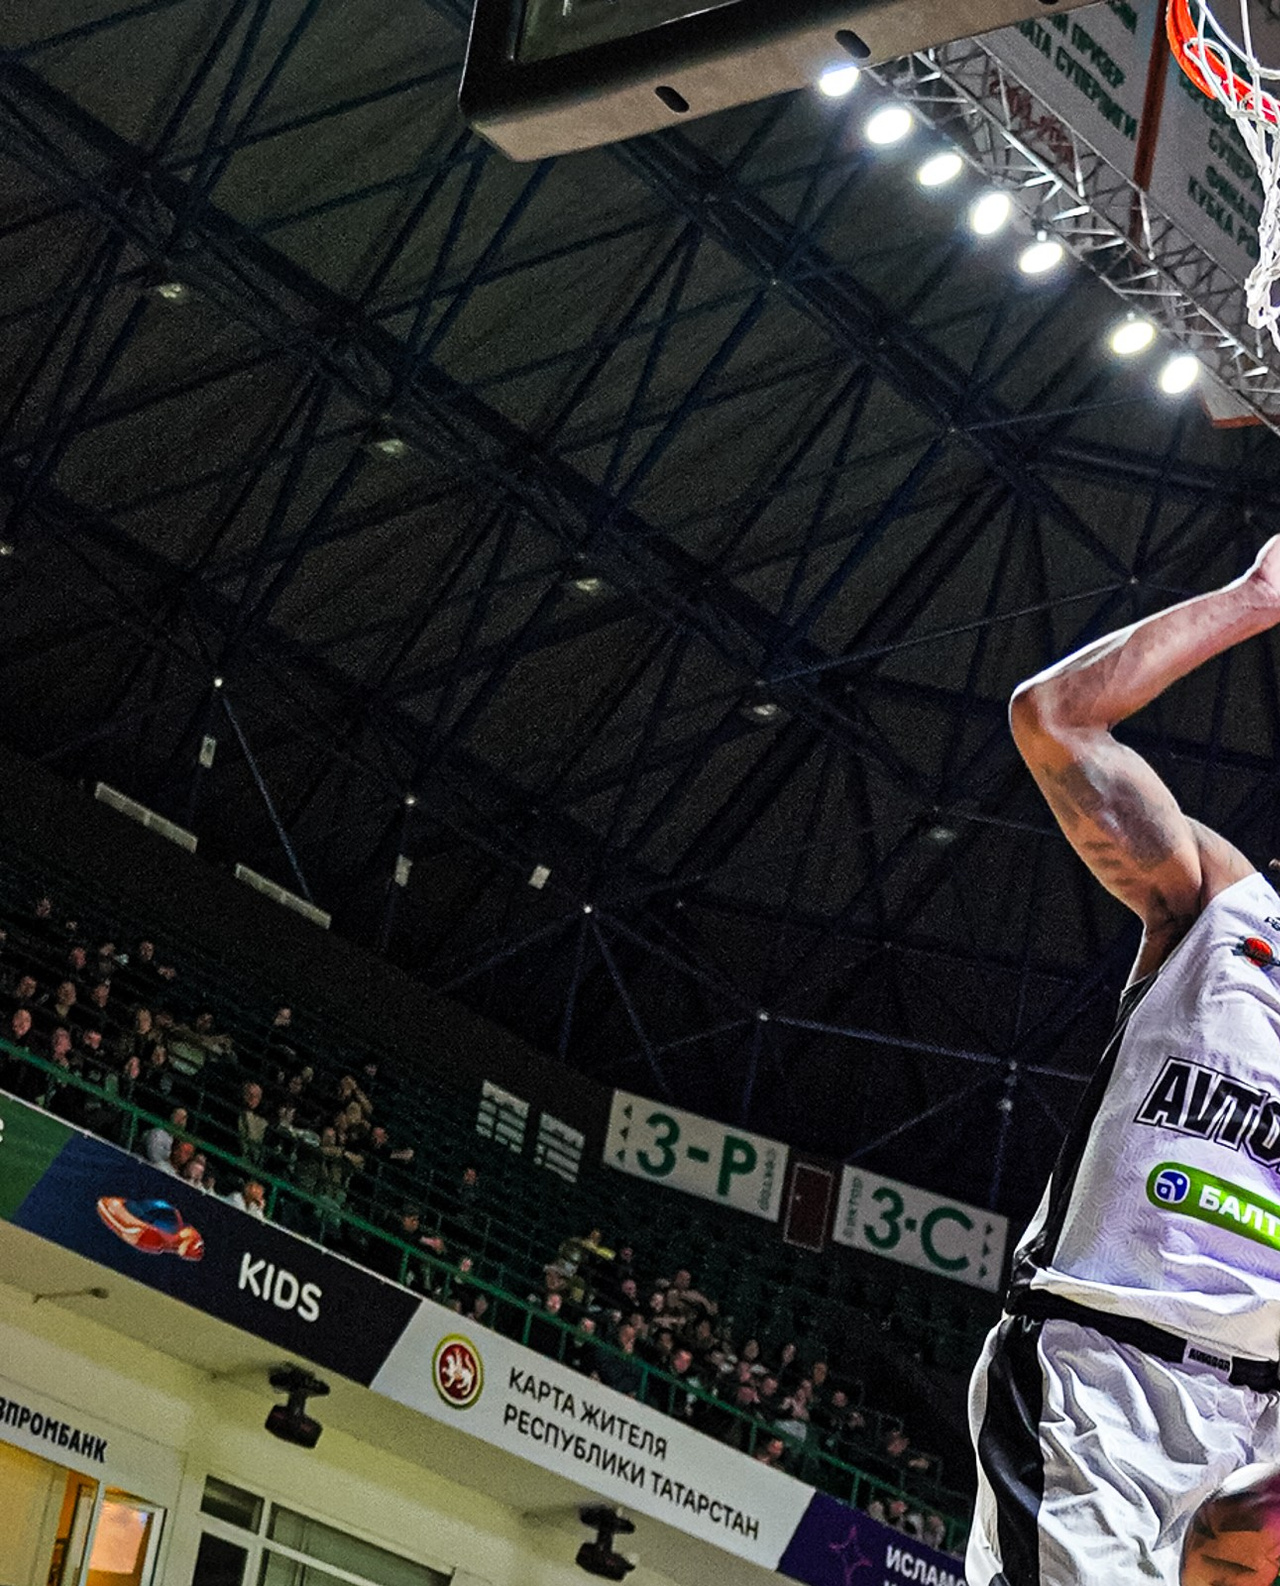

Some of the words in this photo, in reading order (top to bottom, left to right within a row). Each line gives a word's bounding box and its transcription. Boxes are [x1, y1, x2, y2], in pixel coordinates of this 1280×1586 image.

[238, 1251, 323, 1322] KIDS
[508, 1366, 577, 1418] КАРТА
[580, 1401, 668, 1461] ЖИТЕЛЯ
[503, 1403, 646, 1489] РЕСПУБЛИКИ
[651, 1469, 760, 1541] ТАТАРСТАН
